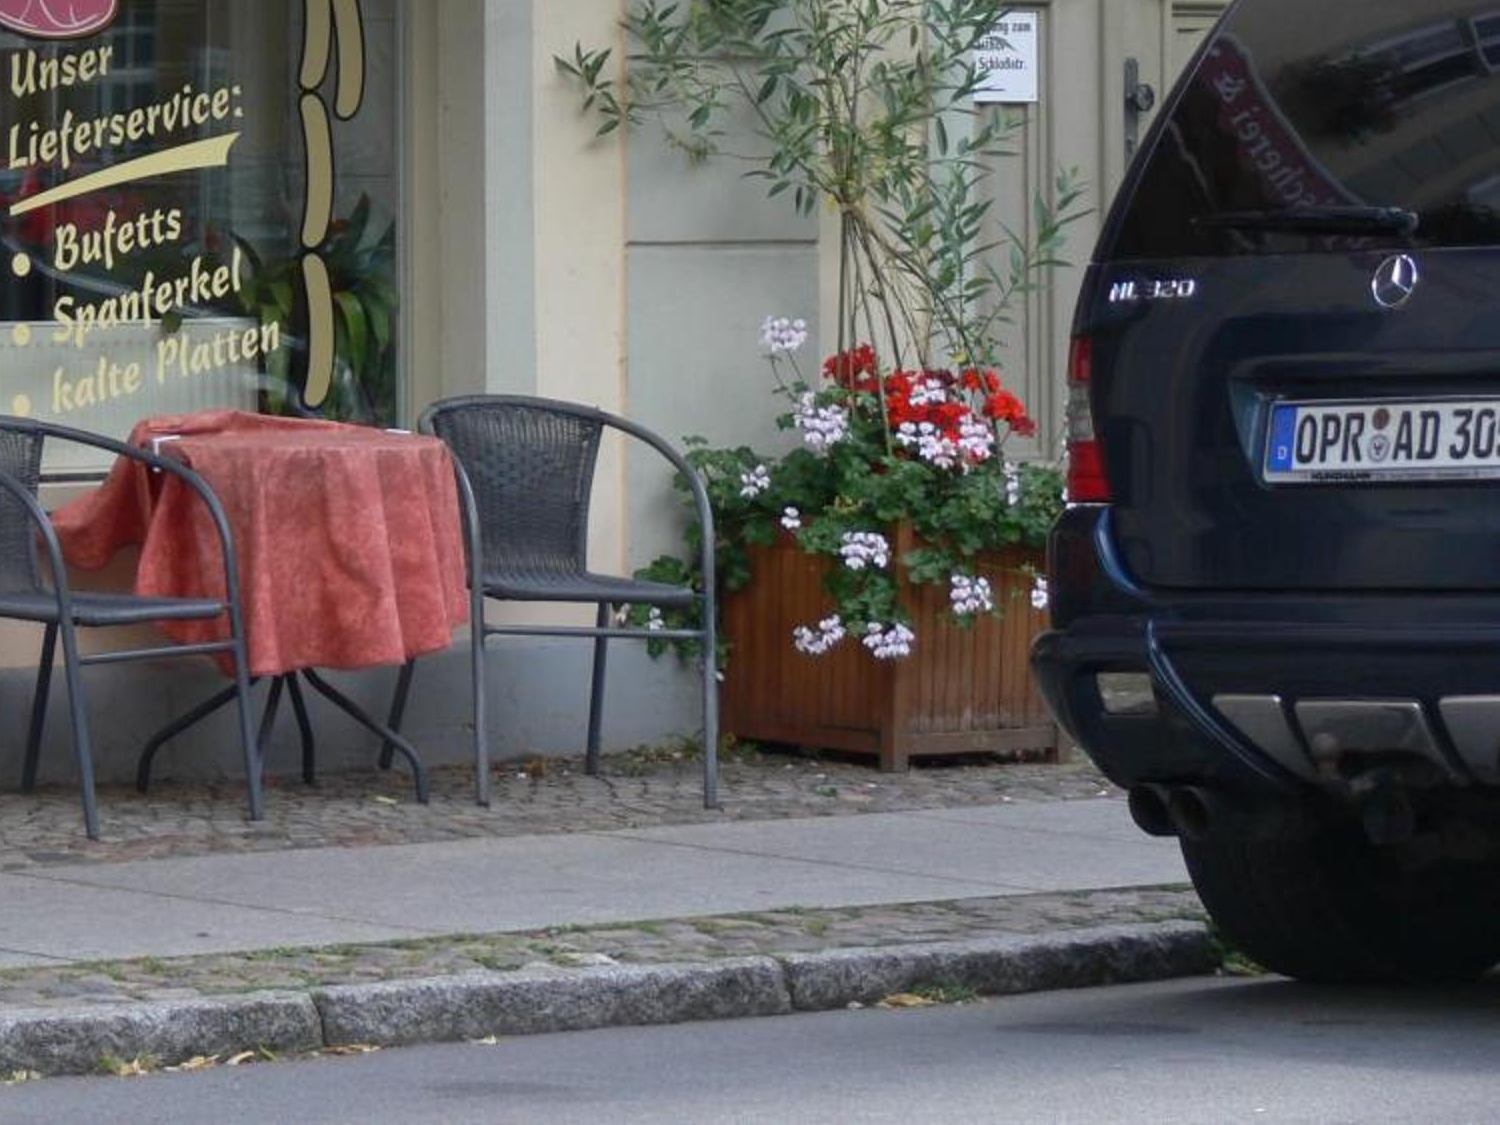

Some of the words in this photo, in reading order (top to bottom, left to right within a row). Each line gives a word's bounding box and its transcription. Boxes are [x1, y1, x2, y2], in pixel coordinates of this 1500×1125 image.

[11, 44, 113, 98] Unser
[9, 83, 244, 171] Lieferservice:
[54, 209, 182, 271] Bufetts
[52, 246, 241, 348] Spanferkel
[52, 356, 142, 414] kalte
[157, 320, 280, 383] Platten
[1276, 445, 1288, 460] D
[1296, 412, 1365, 464] OPR
[1392, 409, 1441, 461] AD
[1449, 408, 1500, 460] 30
